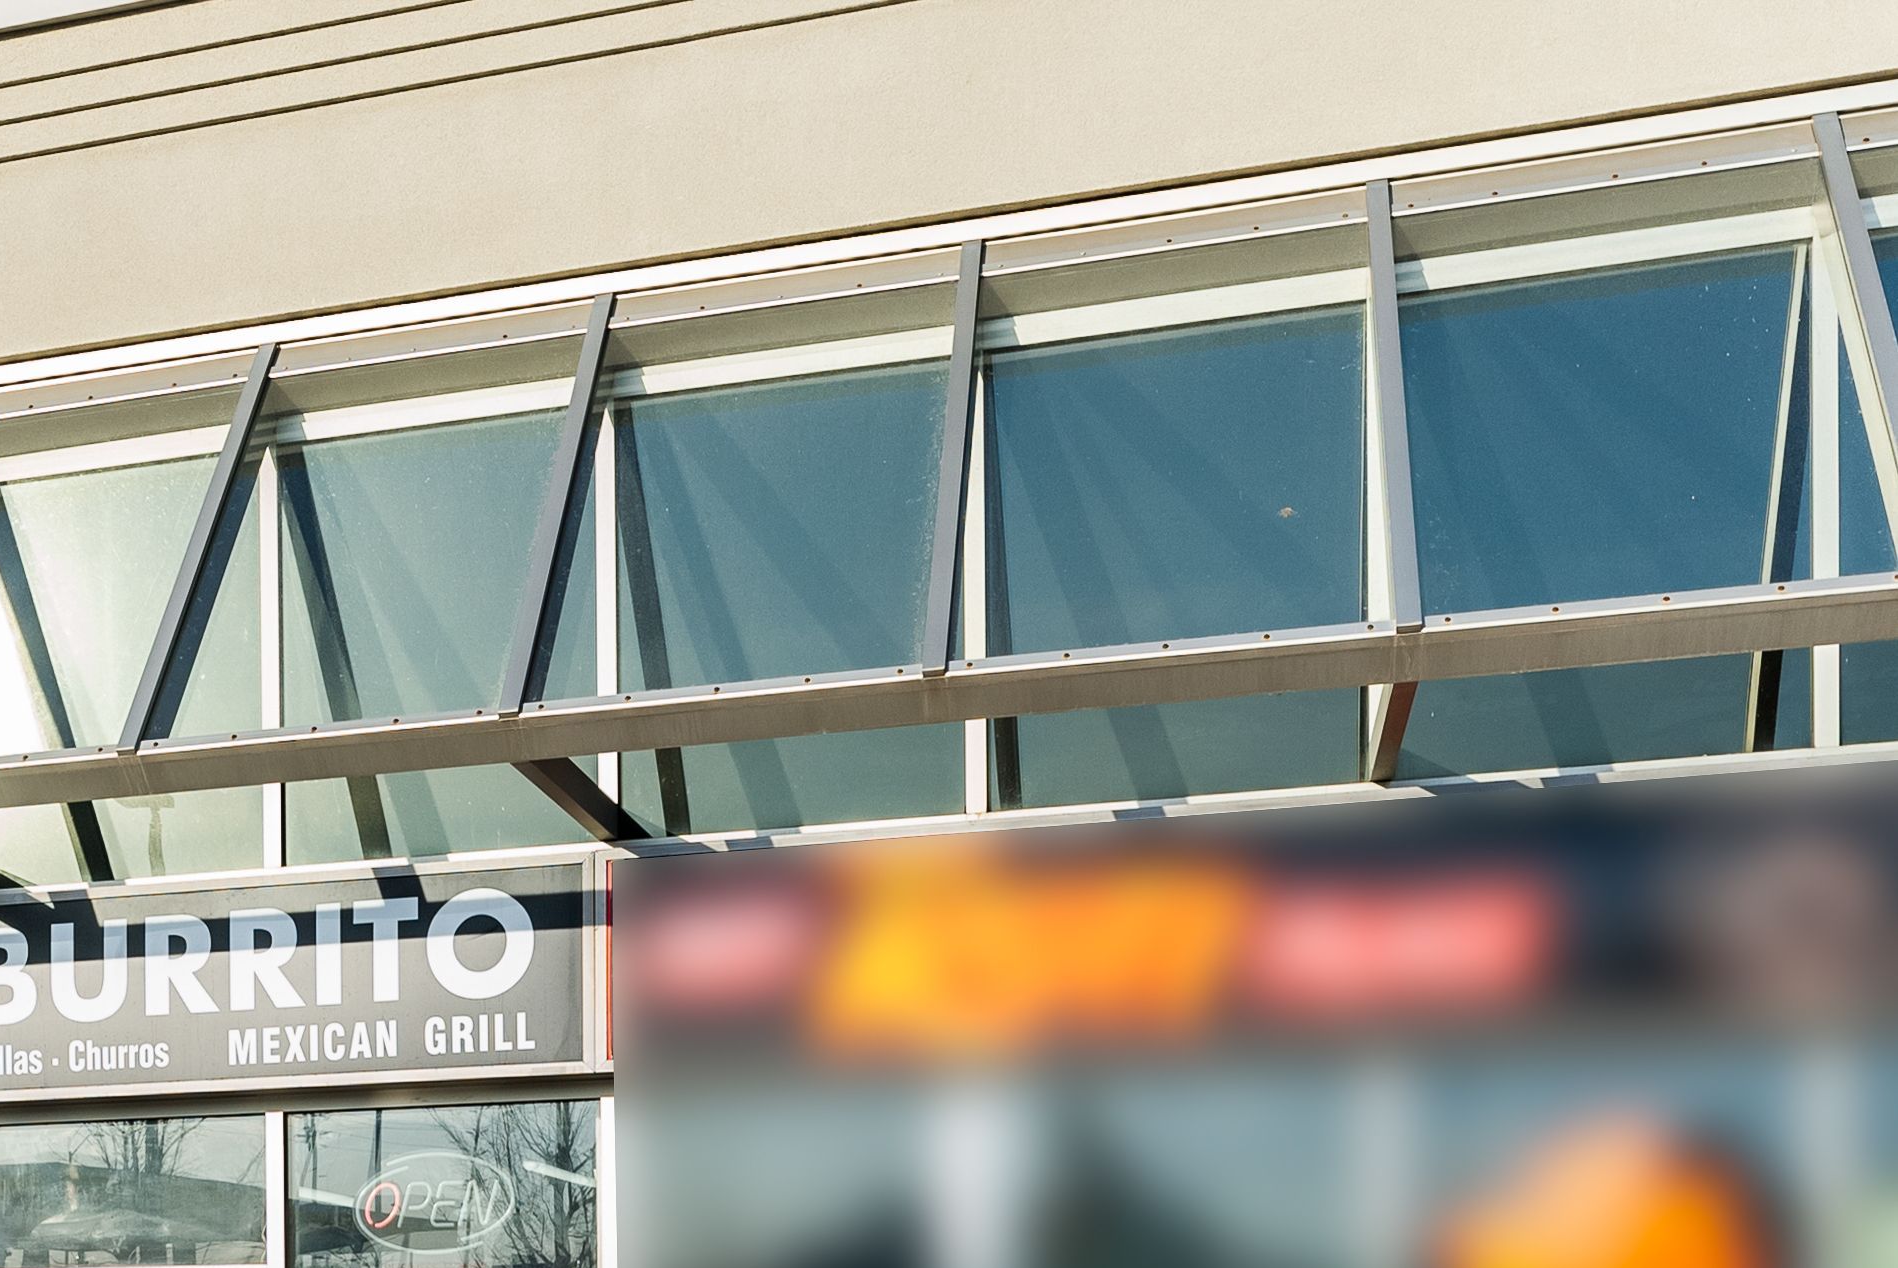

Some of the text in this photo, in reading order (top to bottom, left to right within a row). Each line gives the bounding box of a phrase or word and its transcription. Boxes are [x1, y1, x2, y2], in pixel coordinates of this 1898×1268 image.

[68, 1039, 170, 1073] Churros
[227, 1012, 536, 1067] MEXICAN GRILL
[365, 1179, 499, 1229] OPEN
